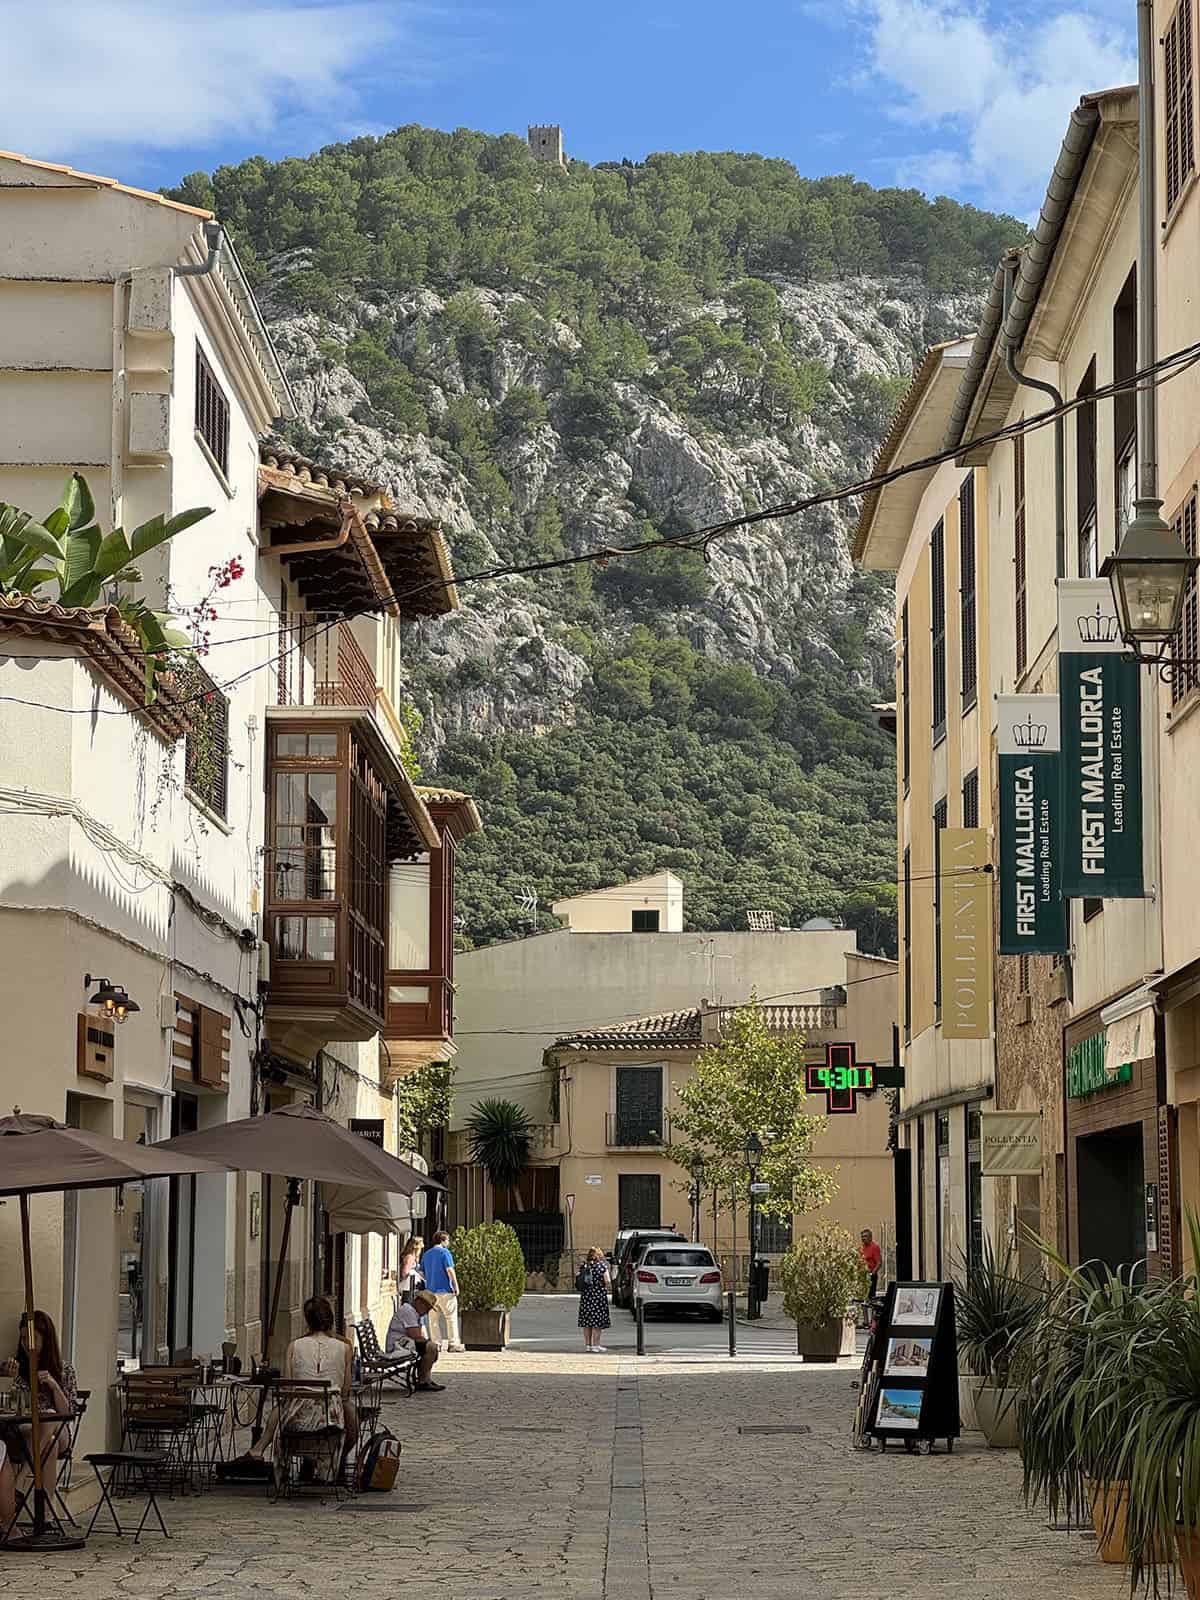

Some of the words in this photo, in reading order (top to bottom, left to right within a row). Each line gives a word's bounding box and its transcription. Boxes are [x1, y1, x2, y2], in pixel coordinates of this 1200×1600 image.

[1079, 666, 1105, 803] MALLORCA
[1111, 707, 1123, 749] Estate
[1111, 752, 1123, 780] Real
[1015, 765, 1035, 878] MALLORCA
[1040, 799, 1050, 834] Estate
[1111, 783, 1126, 833] Leading
[1040, 836, 1050, 859] Real
[1081, 808, 1105, 874] FIRST
[1040, 861, 1053, 902] Leading
[1016, 881, 1036, 936] FIRST
[953, 838, 977, 1029] POLLENTIA
[985, 1135, 1038, 1144] POLLENTIA
